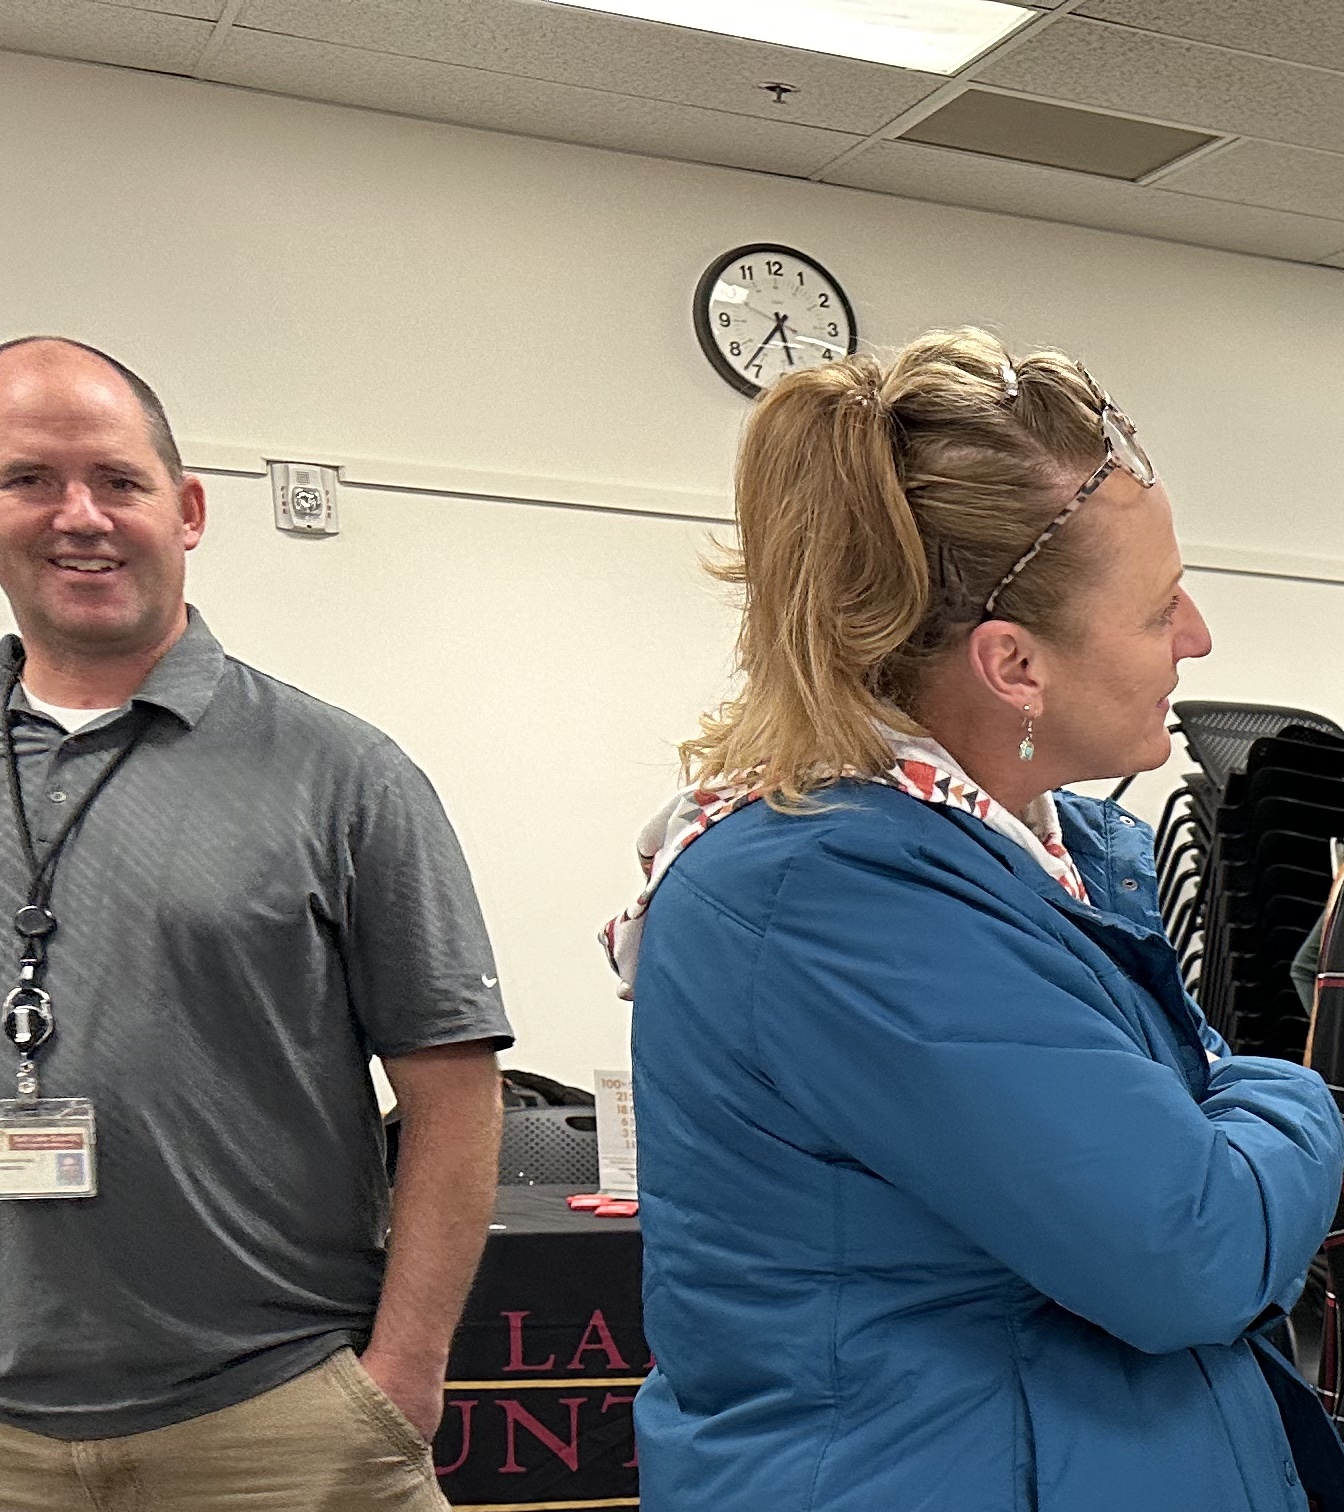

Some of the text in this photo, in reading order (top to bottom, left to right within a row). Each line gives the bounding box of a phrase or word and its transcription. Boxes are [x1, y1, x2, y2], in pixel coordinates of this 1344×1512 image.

[740, 265, 753, 280] 11
[766, 261, 783, 276] 12
[797, 272, 804, 286] 1
[819, 293, 830, 308] 2
[719, 313, 731, 327] 9
[827, 322, 838, 337] 3
[730, 341, 741, 356] 8
[822, 348, 833, 361] 4
[752, 364, 763, 378] 7
[501, 1308, 657, 1372] LA
